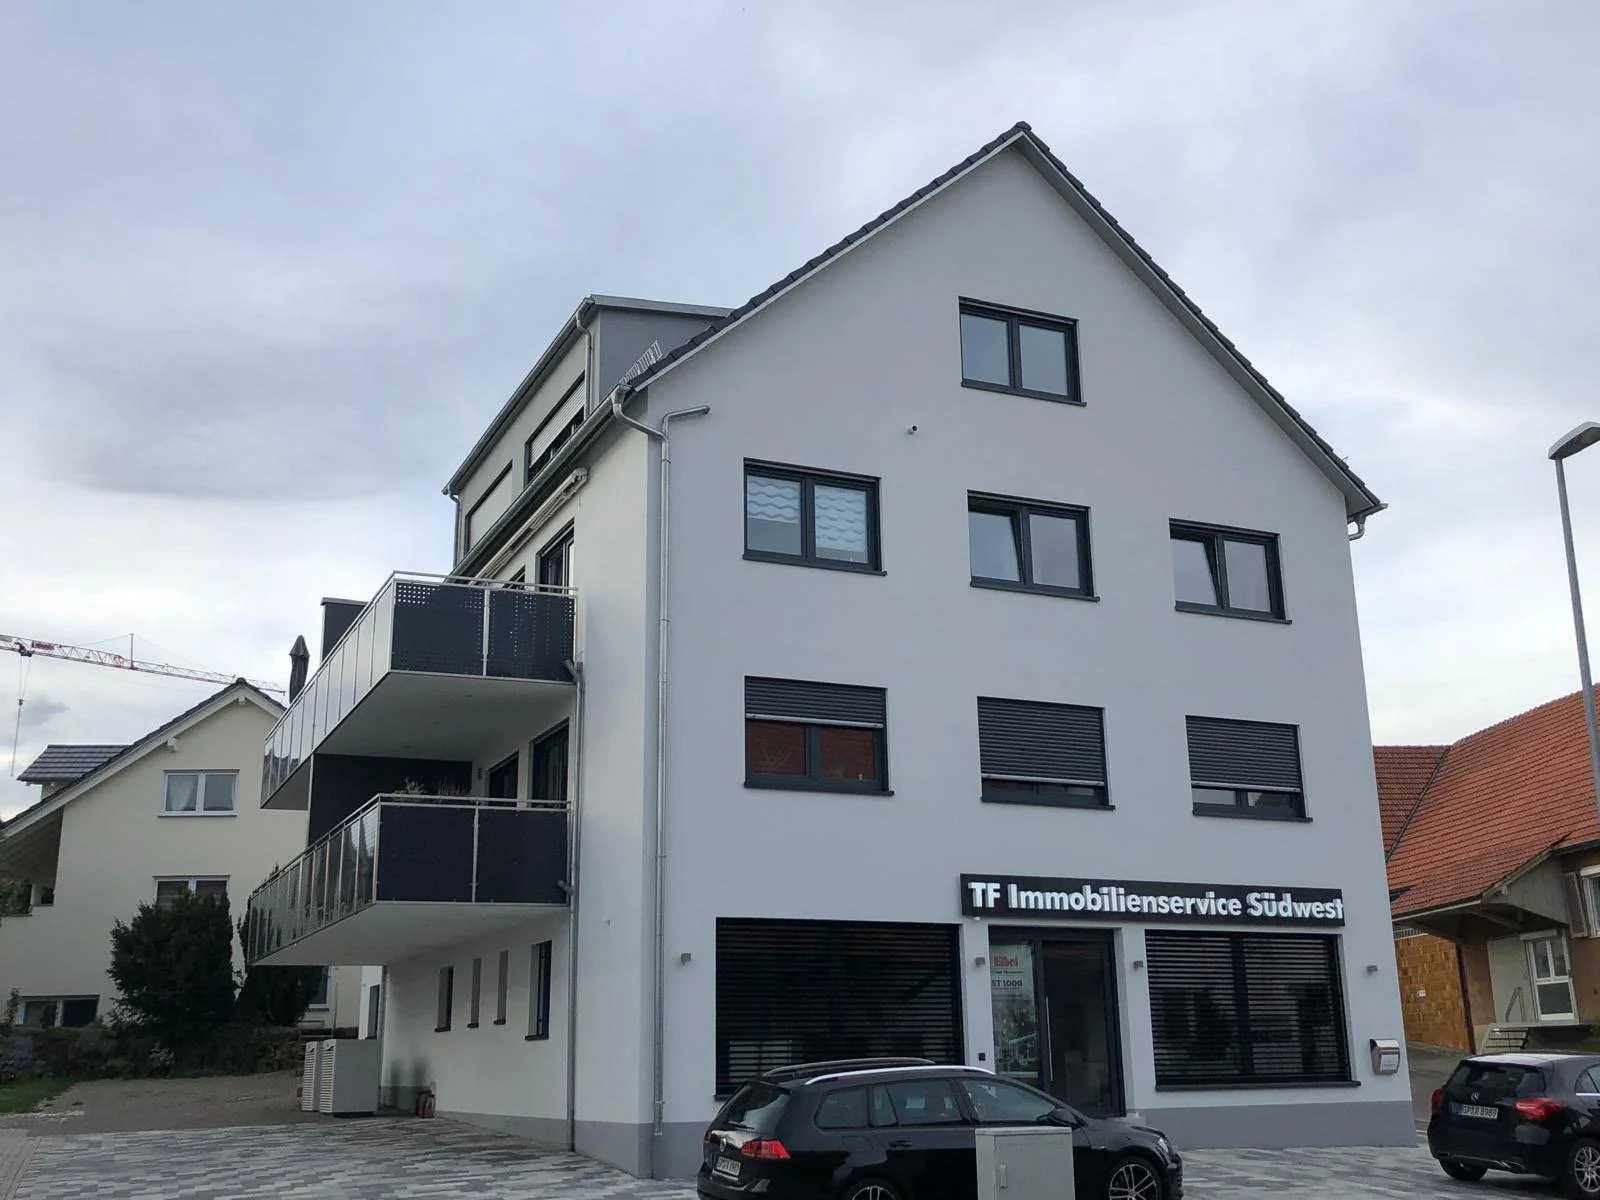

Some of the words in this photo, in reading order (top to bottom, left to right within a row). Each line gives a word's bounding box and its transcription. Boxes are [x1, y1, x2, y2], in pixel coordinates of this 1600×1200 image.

[968, 881, 1000, 908] TF
[1007, 883, 1242, 916] Immobilienservice
[1246, 892, 1343, 919] Südwest
